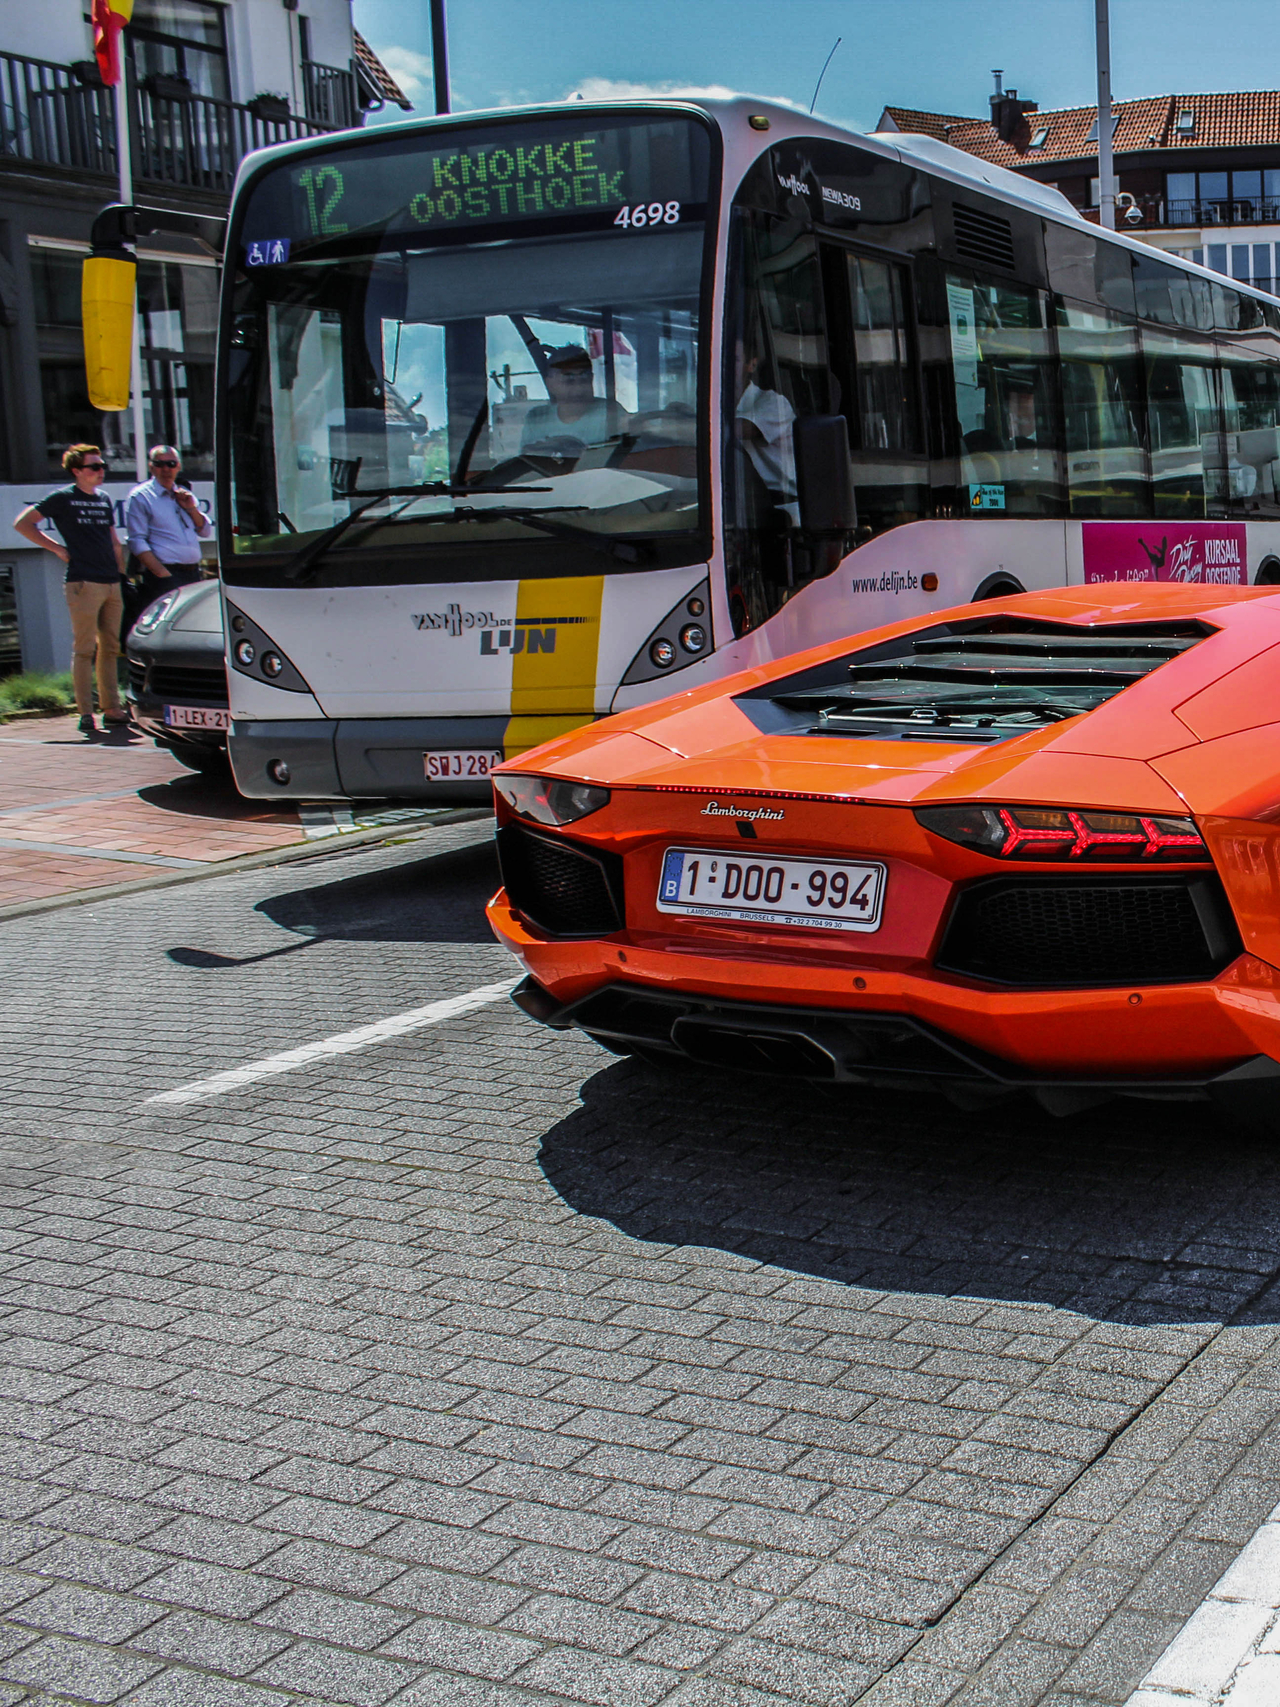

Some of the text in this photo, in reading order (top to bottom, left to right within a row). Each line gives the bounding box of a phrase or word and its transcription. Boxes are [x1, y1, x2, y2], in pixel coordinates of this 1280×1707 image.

[299, 139, 598, 236] 12 KNOKKE
[410, 170, 626, 223] OOSTHOEK
[613, 200, 681, 229] 4698
[1204, 539, 1241, 564] KURSAAL
[852, 569, 918, 595] www.delijn.be
[500, 618, 513, 627] DE
[480, 628, 557, 656] LIJN
[172, 709, 230, 727] 1-LEX-21
[700, 801, 785, 821] Lamborghini
[665, 880, 677, 897] B
[686, 908, 732, 918] LAMBORGHINI
[739, 912, 775, 922] BRUSSELS
